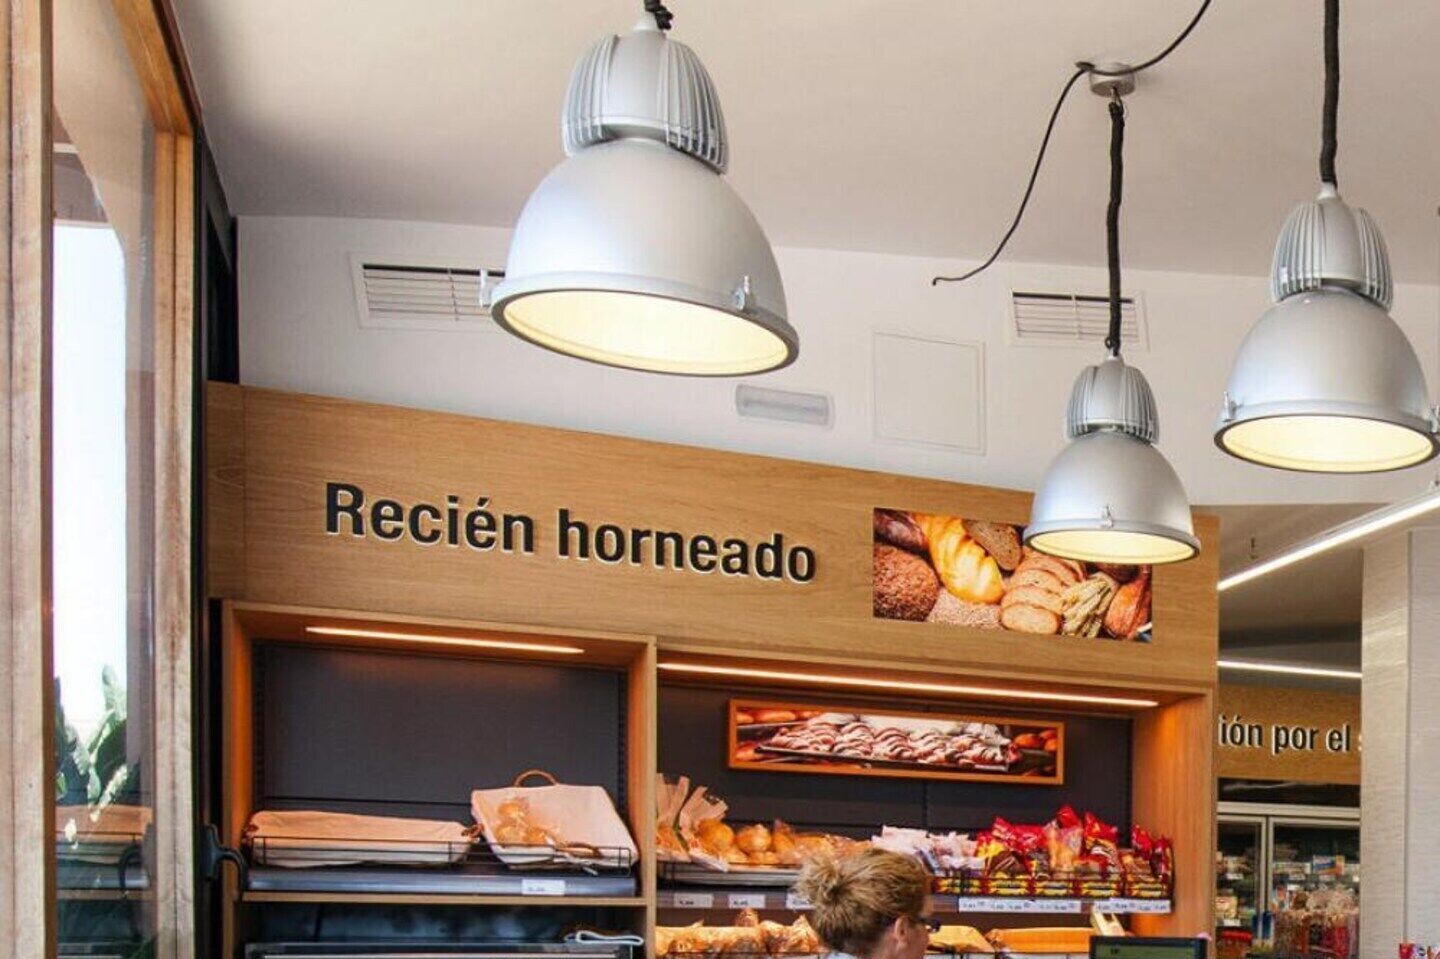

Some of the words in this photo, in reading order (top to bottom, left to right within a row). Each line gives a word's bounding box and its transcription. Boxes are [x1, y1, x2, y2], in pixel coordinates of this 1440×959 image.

[325, 481, 535, 554] Recién
[557, 507, 818, 585] horneado
[1219, 714, 1264, 747] ión
[1271, 724, 1319, 756] por
[1325, 723, 1351, 753] el
